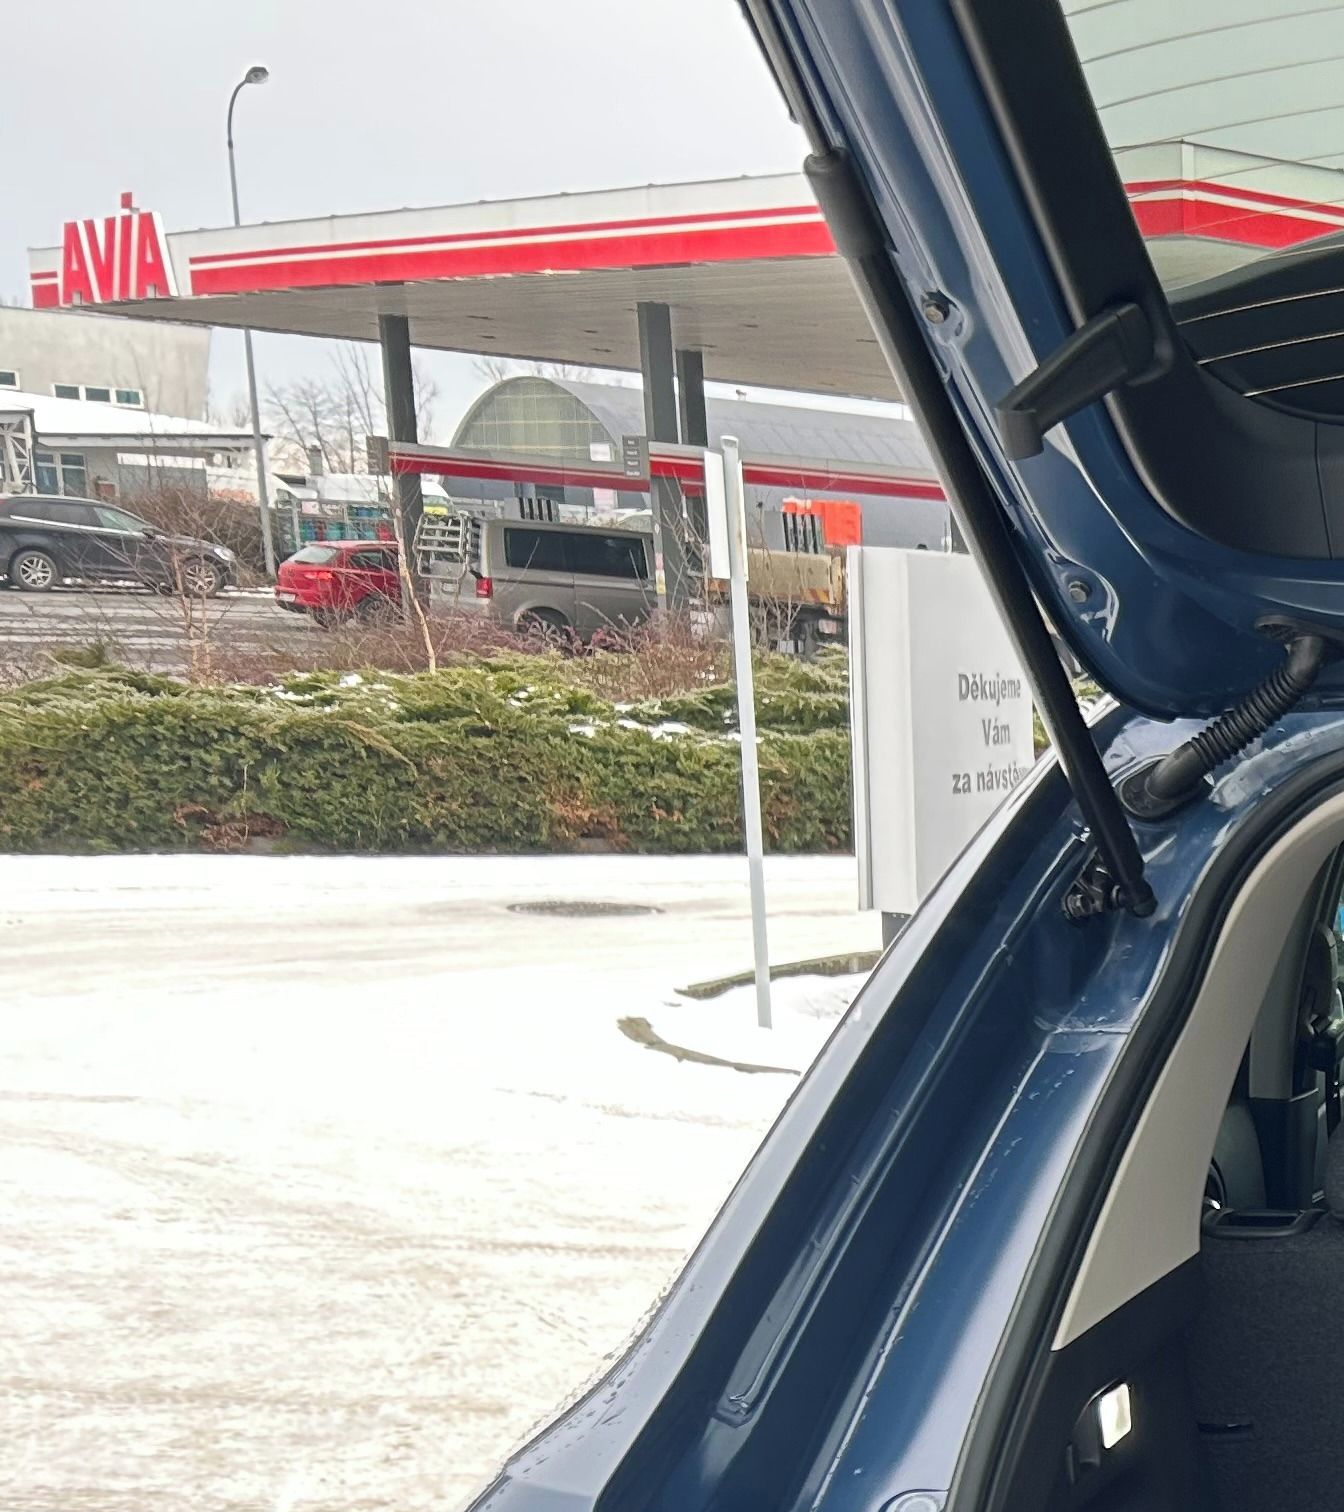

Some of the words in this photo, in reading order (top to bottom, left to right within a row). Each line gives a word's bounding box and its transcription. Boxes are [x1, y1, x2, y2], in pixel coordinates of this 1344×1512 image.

[62, 192, 172, 305] AVIA
[958, 673, 1021, 707] Děkujeme
[982, 717, 1010, 747] Vám
[952, 771, 971, 794] za
